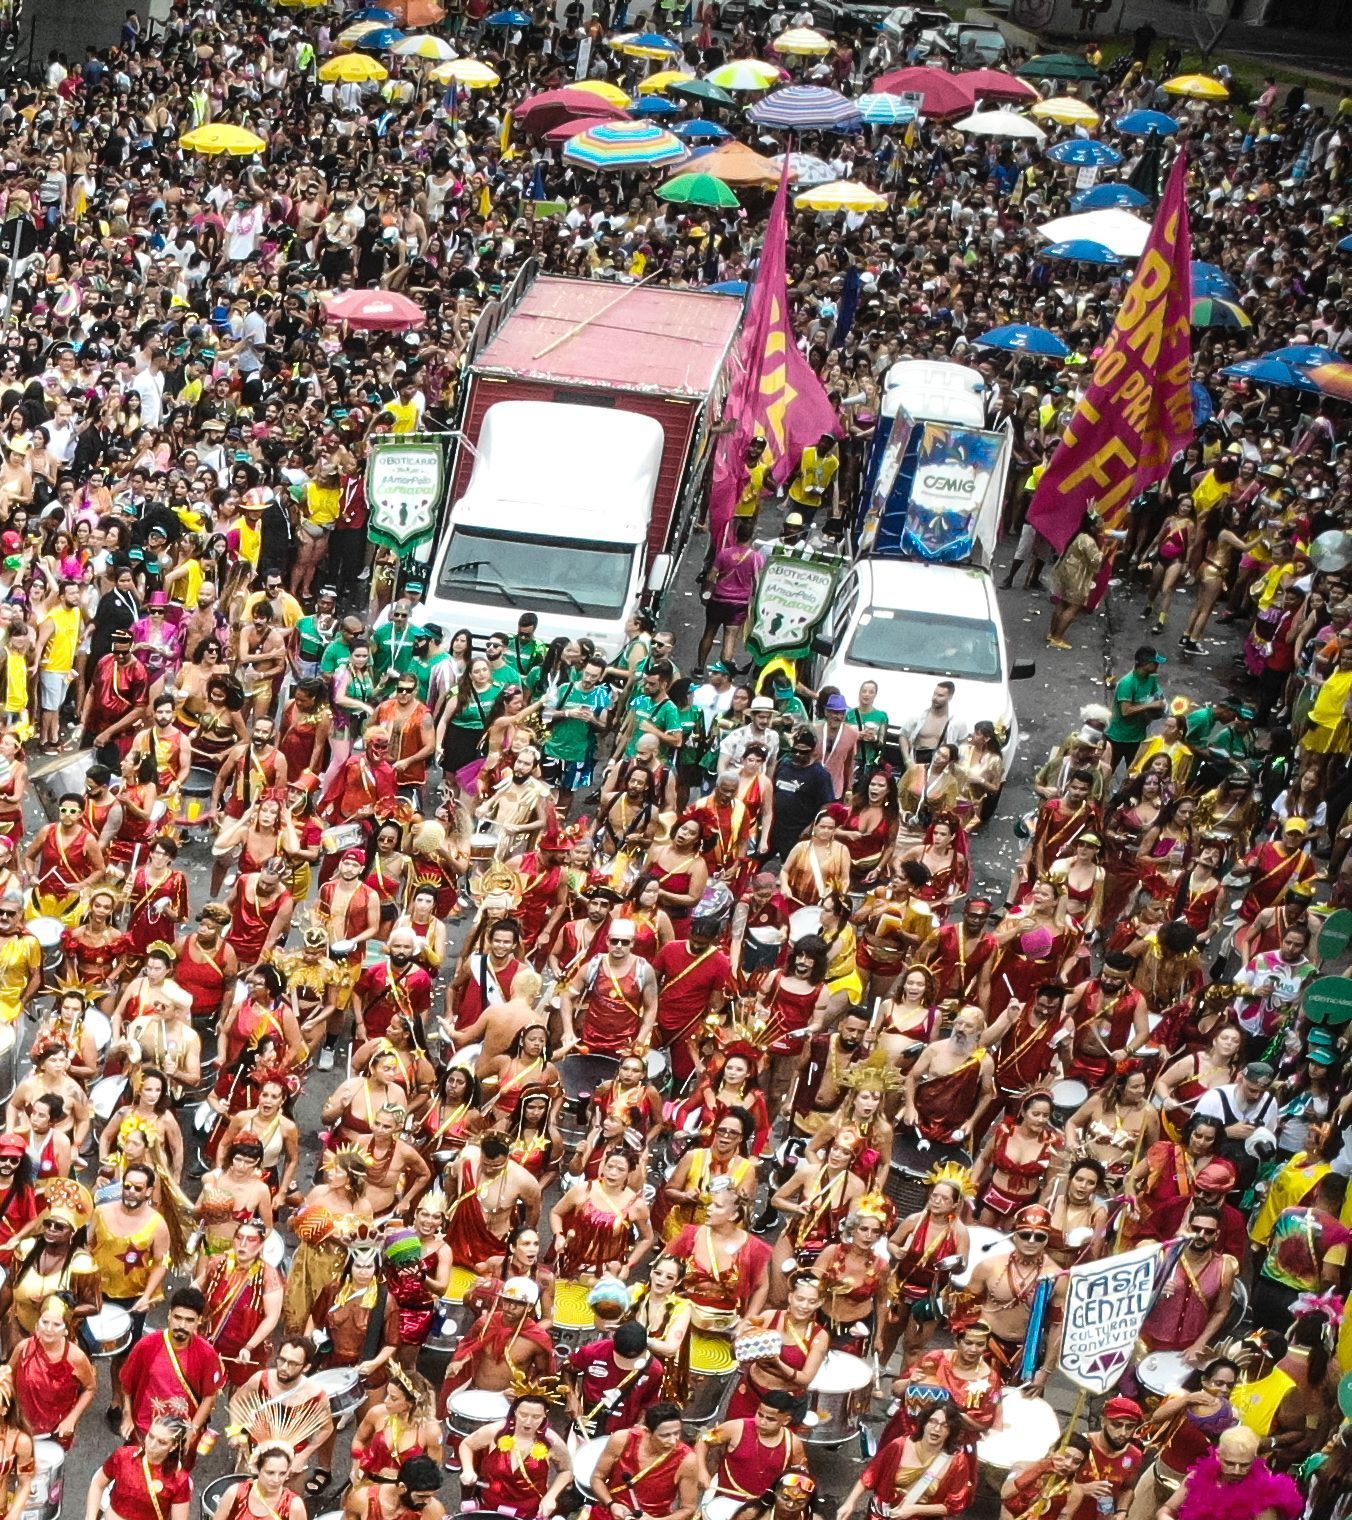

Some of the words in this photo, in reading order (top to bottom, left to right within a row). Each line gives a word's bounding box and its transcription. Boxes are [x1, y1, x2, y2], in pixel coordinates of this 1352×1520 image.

[923, 475, 976, 493] CEMIG
[1074, 1261, 1150, 1302] CASA
[1072, 1295, 1149, 1330] GENTIL
[1069, 1317, 1138, 1342] CULTURAS
